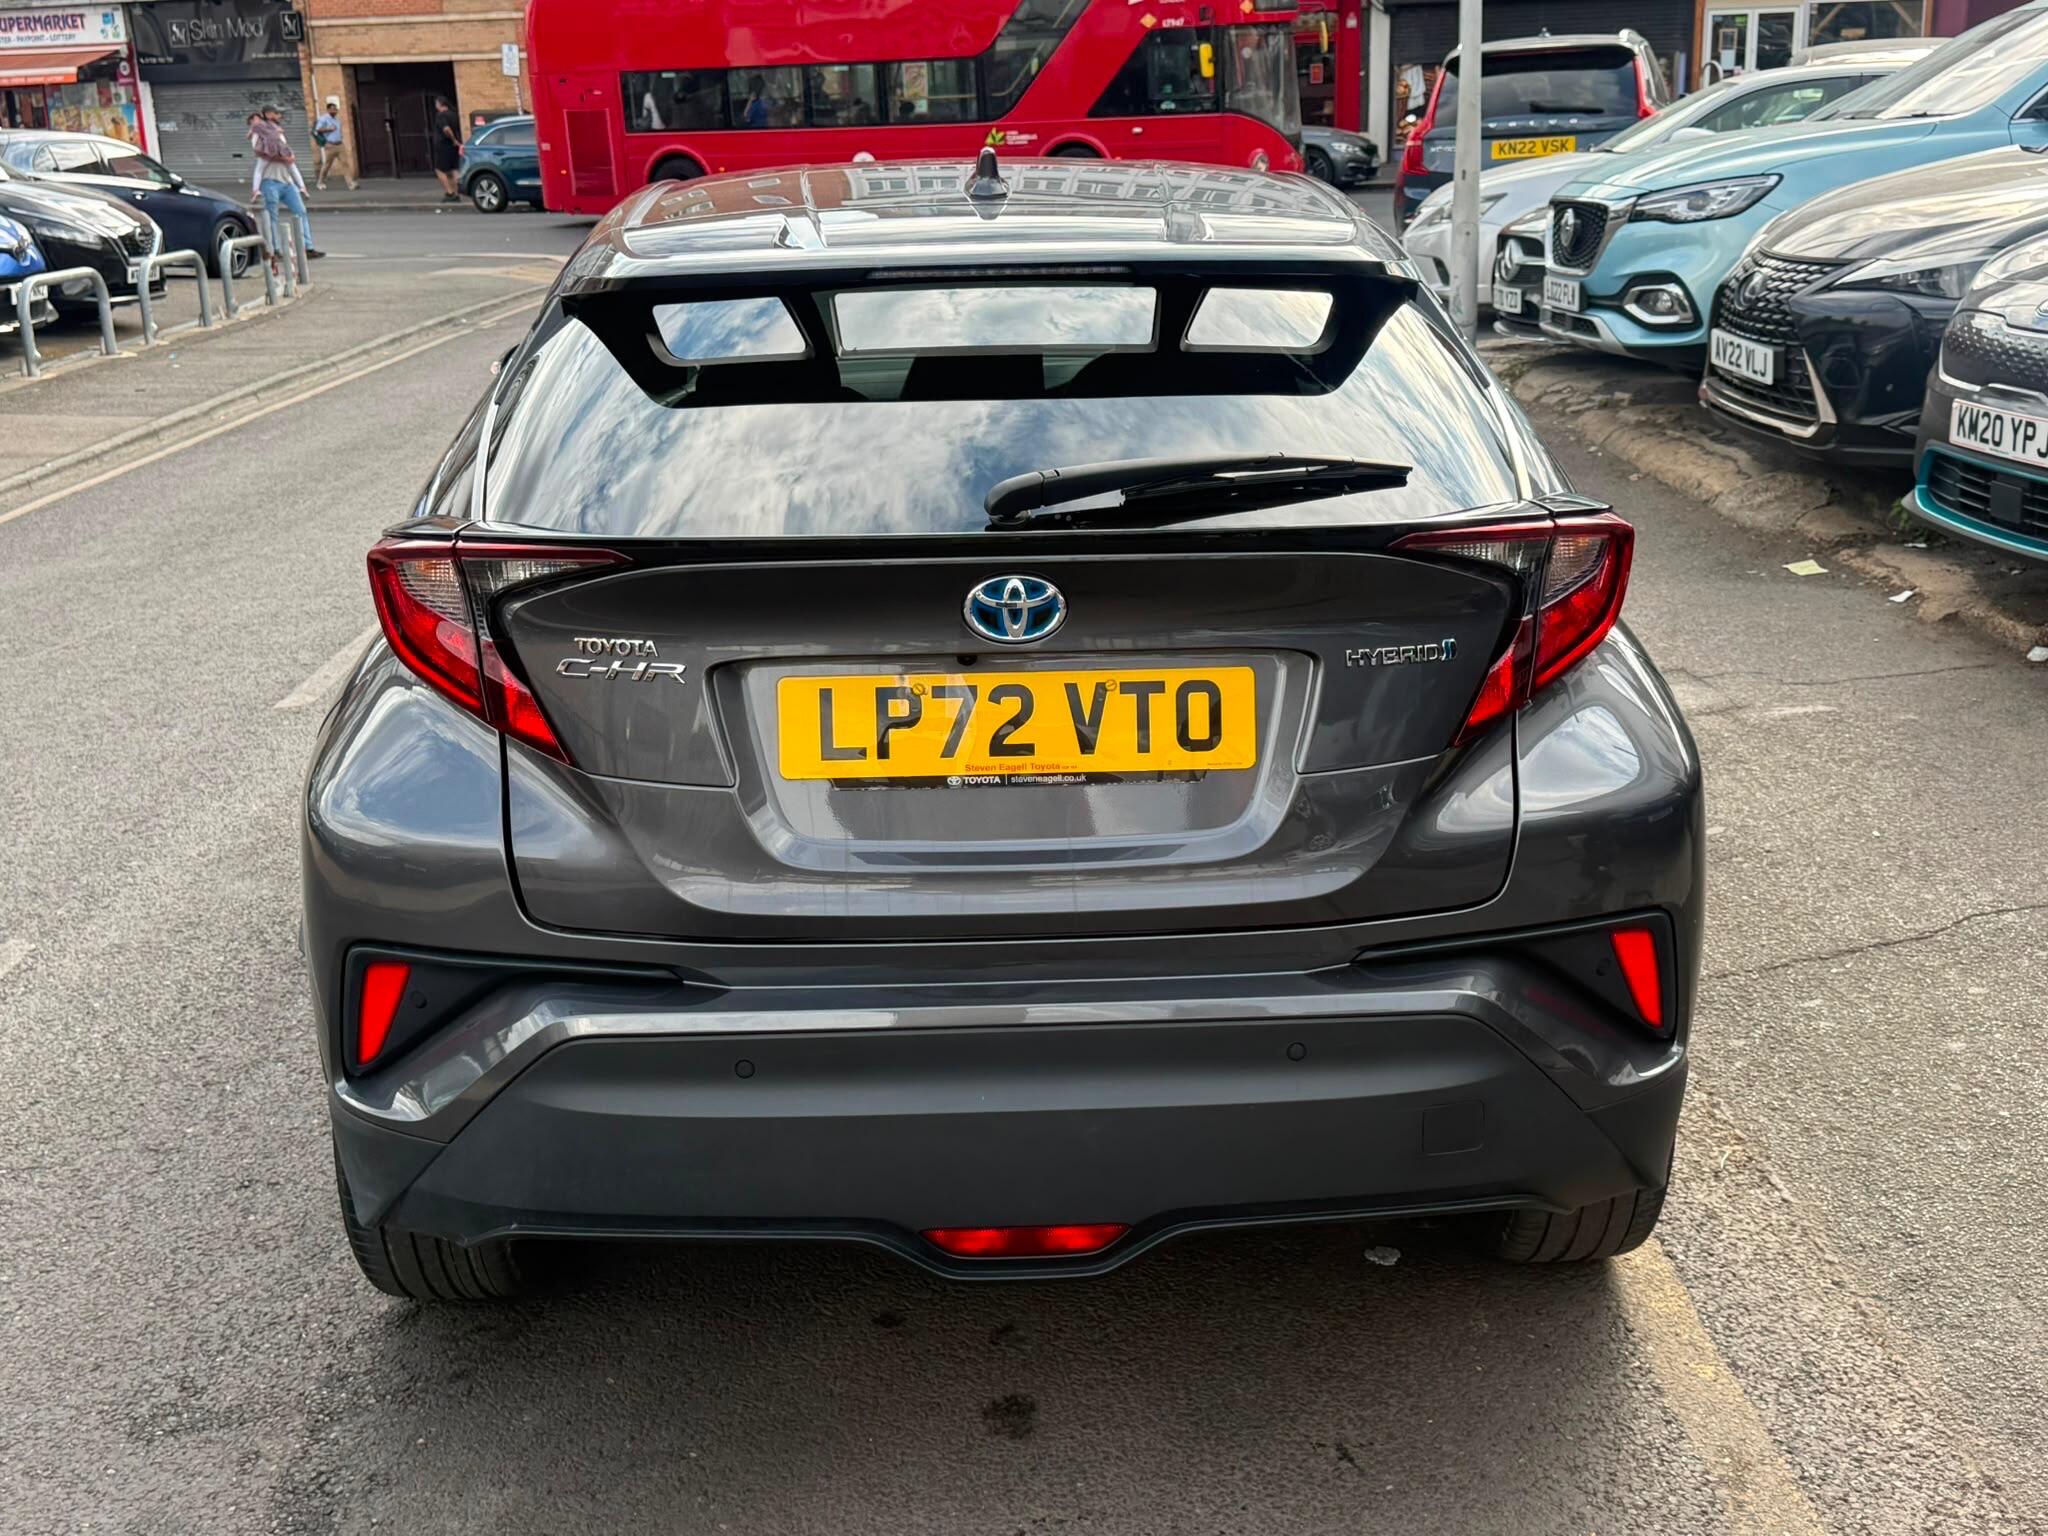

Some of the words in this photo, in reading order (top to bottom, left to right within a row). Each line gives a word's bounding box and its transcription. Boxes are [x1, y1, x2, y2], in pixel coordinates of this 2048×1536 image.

[50, 33, 76, 41] LOTTERY
[1498, 140, 1537, 155] KN22
[1541, 138, 1569, 153] VSK
[1715, 335, 1742, 368] AV22
[1745, 345, 1767, 378] VLJ
[1957, 404, 2004, 448] KM20
[2011, 416, 2048, 459] YPJ
[574, 637, 658, 657] TOYOTA
[1345, 643, 1439, 667] HYBRID
[556, 658, 686, 684] C-HR
[819, 684, 1036, 761] LP72
[1063, 679, 1222, 755] VTO
[963, 776, 1001, 784] TOYOTA
[1010, 773, 1087, 784] steveneagell.co.uk
[964, 763, 997, 773] Steven
[1000, 763, 1027, 773] Eagell
[1031, 762, 1060, 772] Toyota
